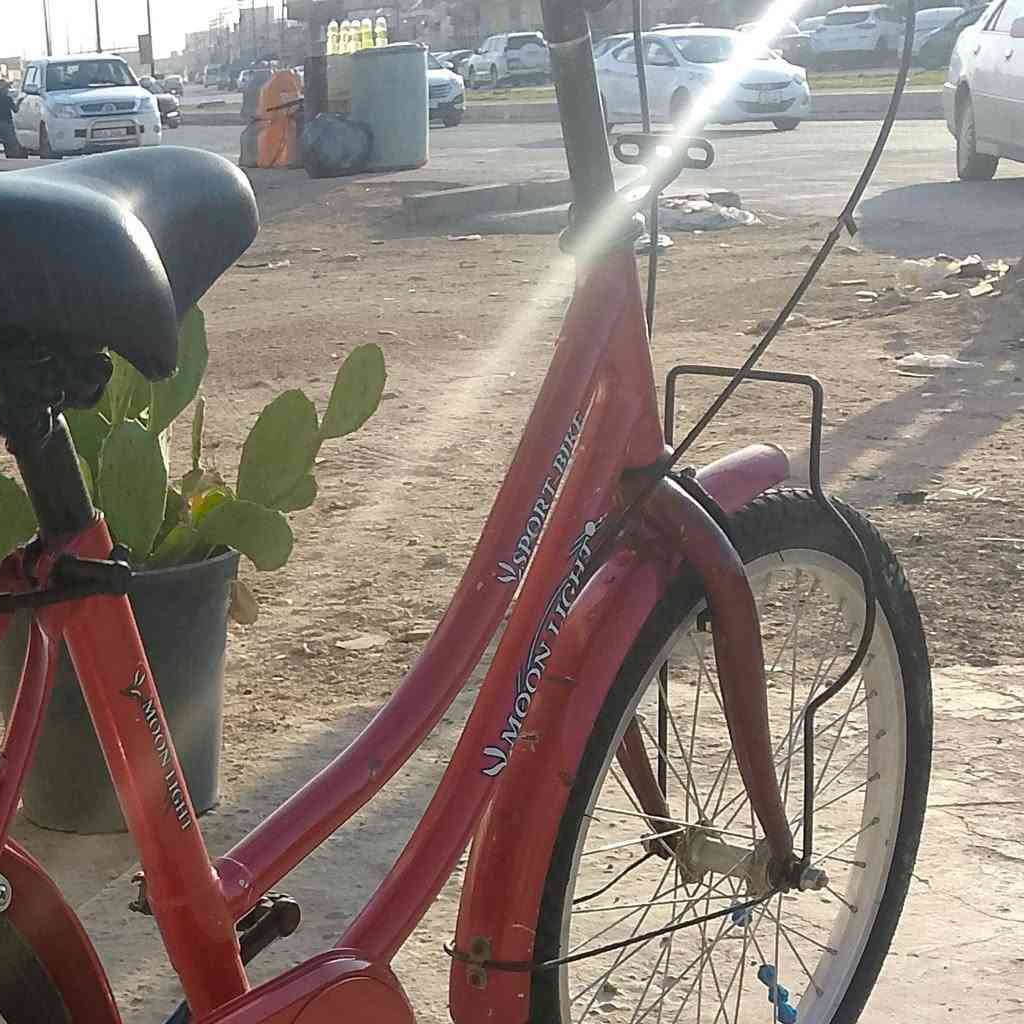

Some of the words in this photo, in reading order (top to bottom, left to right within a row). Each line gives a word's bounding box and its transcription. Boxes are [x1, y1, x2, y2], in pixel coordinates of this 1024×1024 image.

[512, 477, 555, 566] SPORT
[553, 410, 583, 474] BIKE
[500, 642, 552, 745] MOON
[548, 535, 592, 635] LIGHT
[143, 699, 172, 768] MOON
[165, 769, 192, 831] LIGHT
